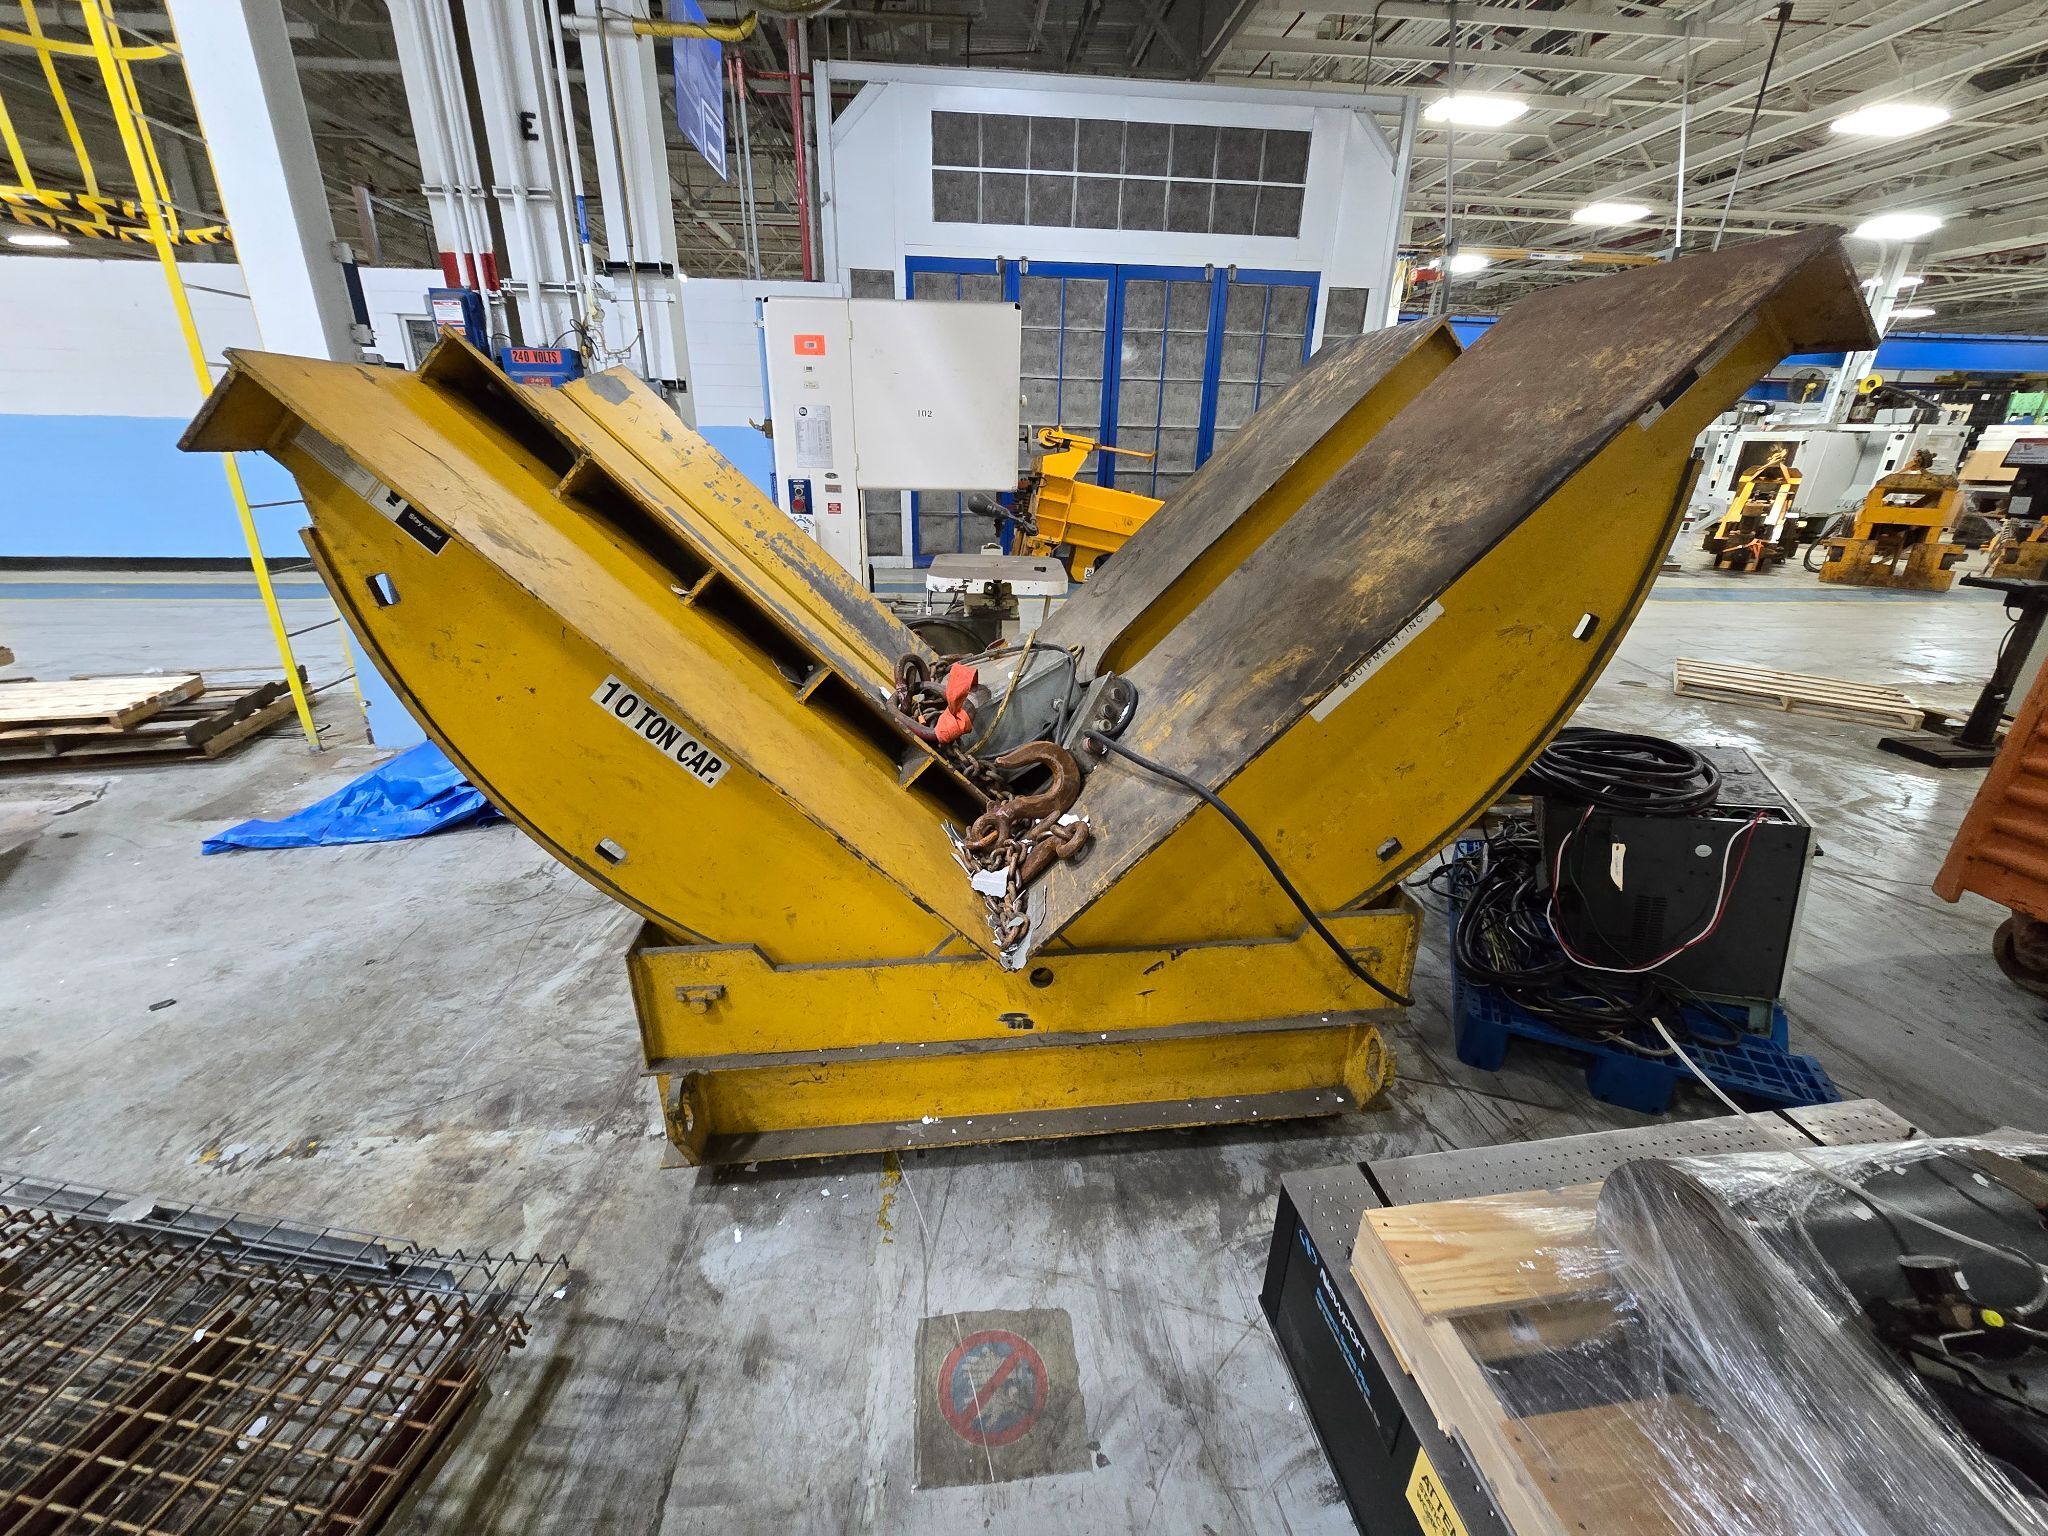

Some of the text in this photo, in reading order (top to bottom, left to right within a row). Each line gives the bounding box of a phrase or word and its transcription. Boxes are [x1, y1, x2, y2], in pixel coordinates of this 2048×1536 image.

[520, 111, 539, 141] E
[512, 350, 557, 363] 240 VOLTS
[917, 409, 933, 417] 102
[408, 512, 423, 528] Stay
[600, 682, 722, 784] 10 TON CAP.
[1320, 1267, 1367, 1361] Newport
